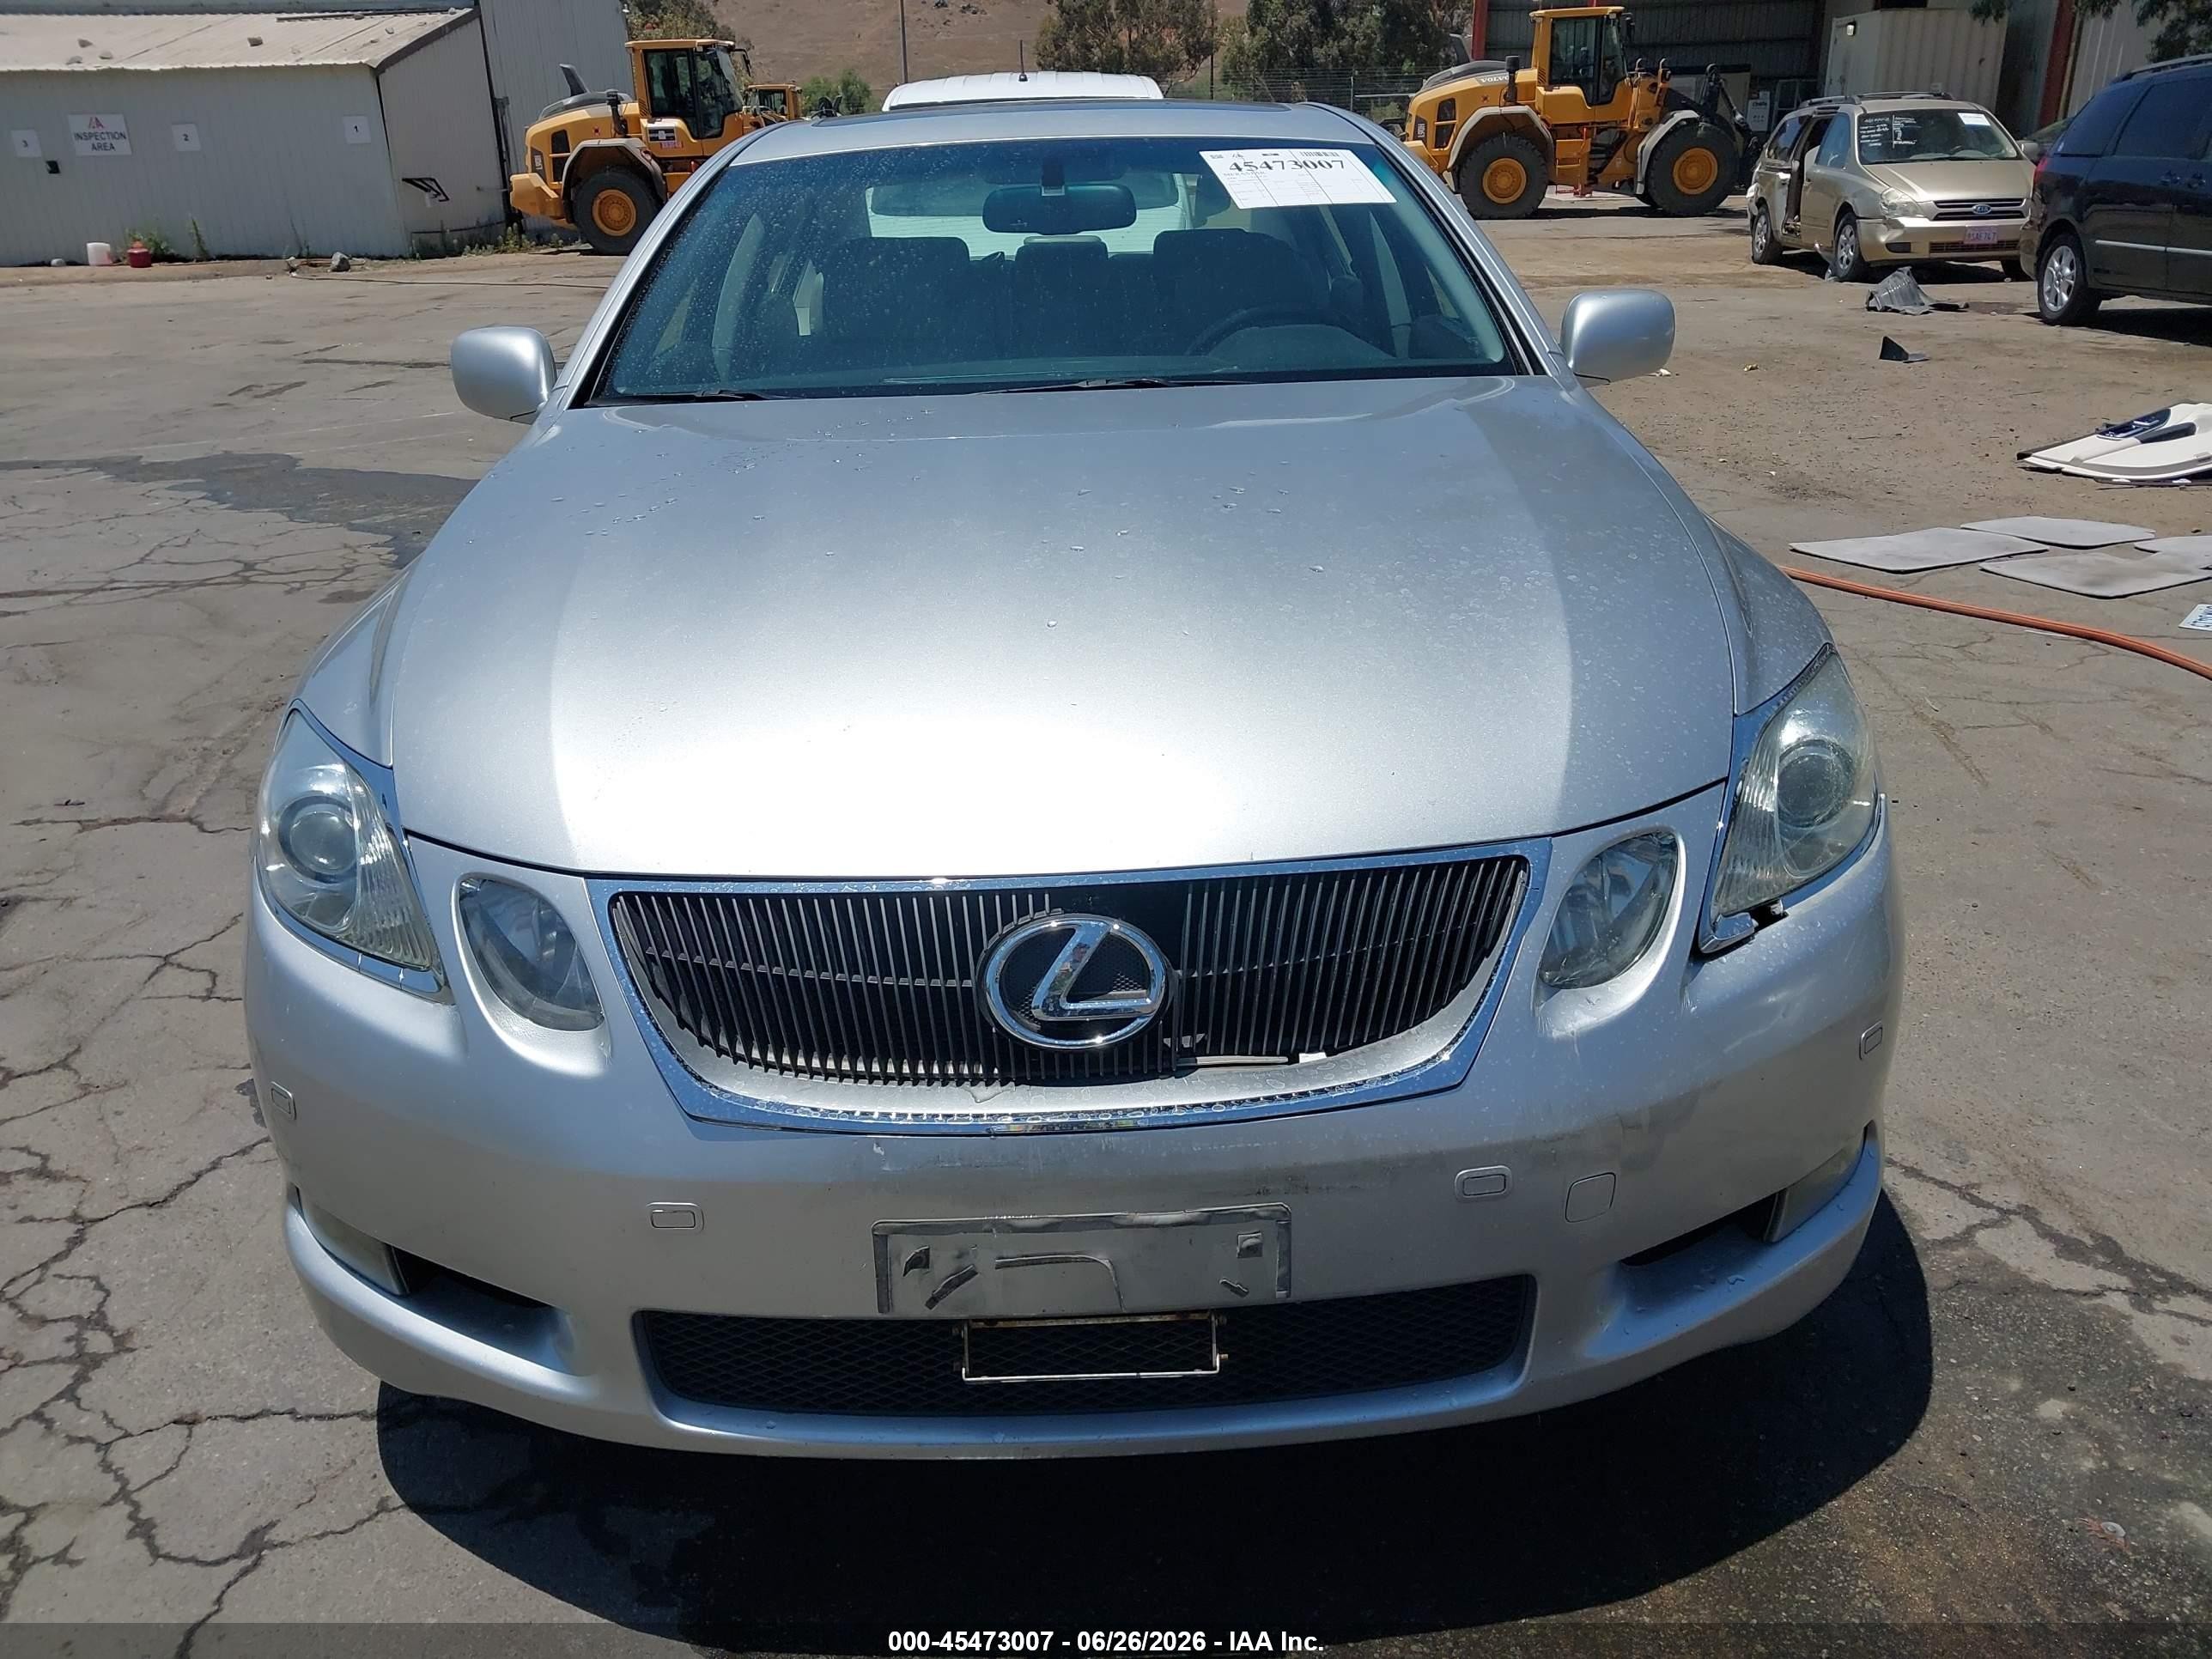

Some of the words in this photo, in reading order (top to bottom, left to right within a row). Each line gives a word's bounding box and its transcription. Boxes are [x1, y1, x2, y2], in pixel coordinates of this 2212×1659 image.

[74, 131, 126, 141] INSPECTION
[183, 133, 190, 142] 2
[91, 142, 116, 151] AREA
[1229, 160, 1345, 172] 45473007
